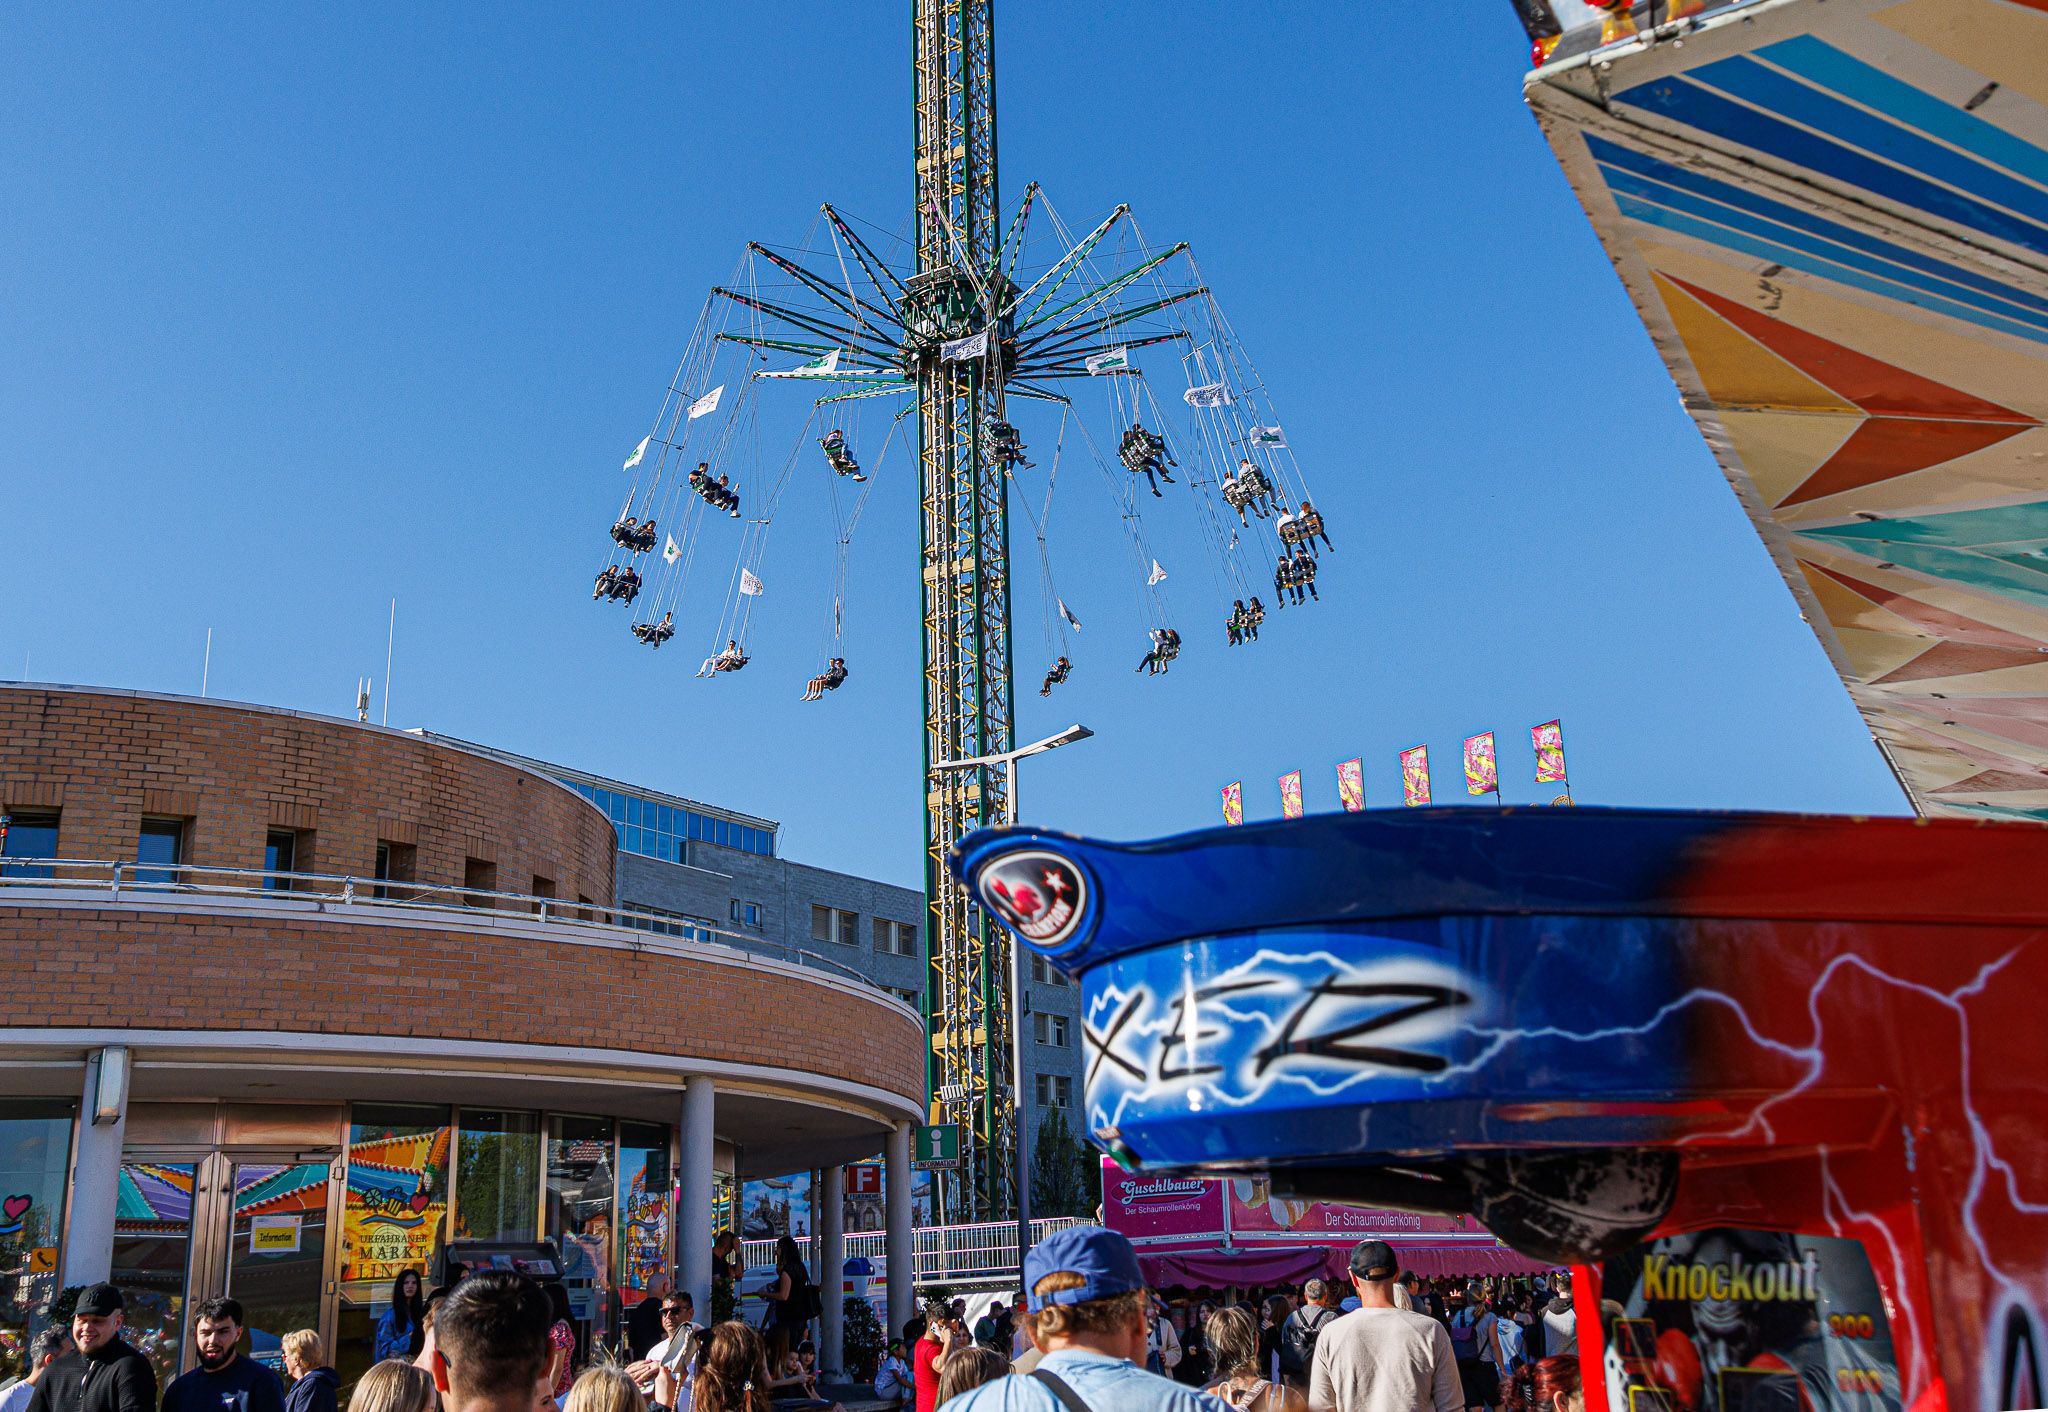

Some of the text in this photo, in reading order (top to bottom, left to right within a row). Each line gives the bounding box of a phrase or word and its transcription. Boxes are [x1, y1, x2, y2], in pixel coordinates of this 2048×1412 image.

[918, 1160, 957, 1168] INFORMATION
[856, 1167, 873, 1192] F
[1120, 1178, 1205, 1205] Guschlbauer
[1125, 1202, 1201, 1215] Der Schaumrollenkönig
[1325, 1211, 1421, 1230] Der Schaumrollenkönig
[259, 1232, 292, 1243] Information
[360, 1234, 428, 1244] URFAHRANER
[359, 1246, 427, 1260] MARKT
[1643, 1249, 1821, 1301] Knockout
